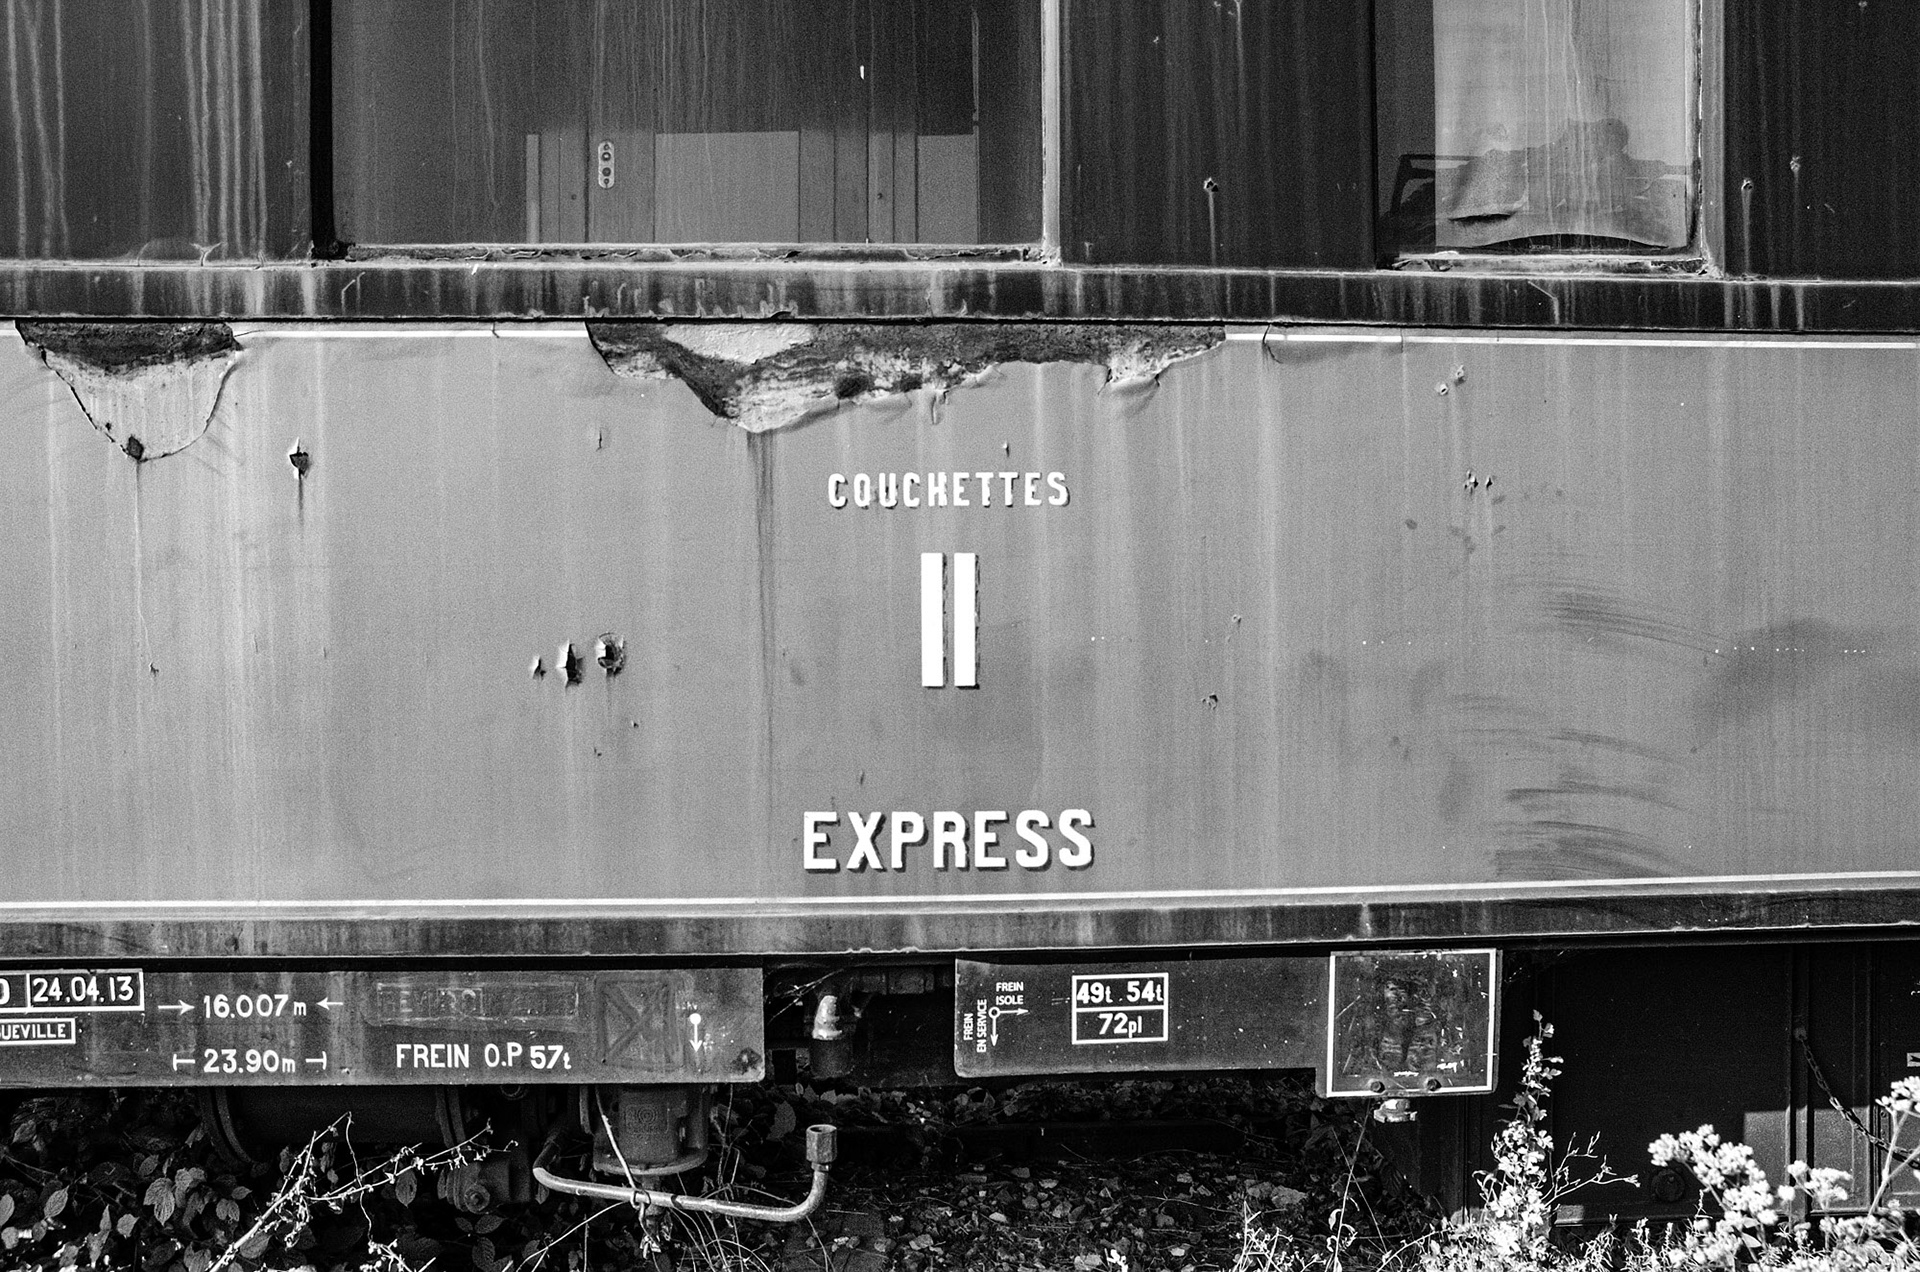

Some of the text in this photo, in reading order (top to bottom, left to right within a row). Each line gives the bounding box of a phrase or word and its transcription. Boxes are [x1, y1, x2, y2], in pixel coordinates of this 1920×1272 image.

[828, 472, 1070, 507] COUCHETTES
[803, 809, 1095, 872] EXPRESS
[32, 976, 134, 1003] 24.04.13
[996, 982, 1024, 992] FREIN
[1077, 980, 1164, 1004] 49t 54t
[203, 994, 306, 1019] 16.007 m
[996, 995, 1024, 1006] ISOLE
[0, 1023, 66, 1040] UEVILLE
[963, 1013, 974, 1041] FREIN
[977, 999, 987, 1053] EN SERVICE
[1098, 1013, 1143, 1039] 72pl
[203, 1049, 295, 1074] 23.90m
[395, 1043, 470, 1069] FREIN
[529, 1045, 572, 1070] 57t
